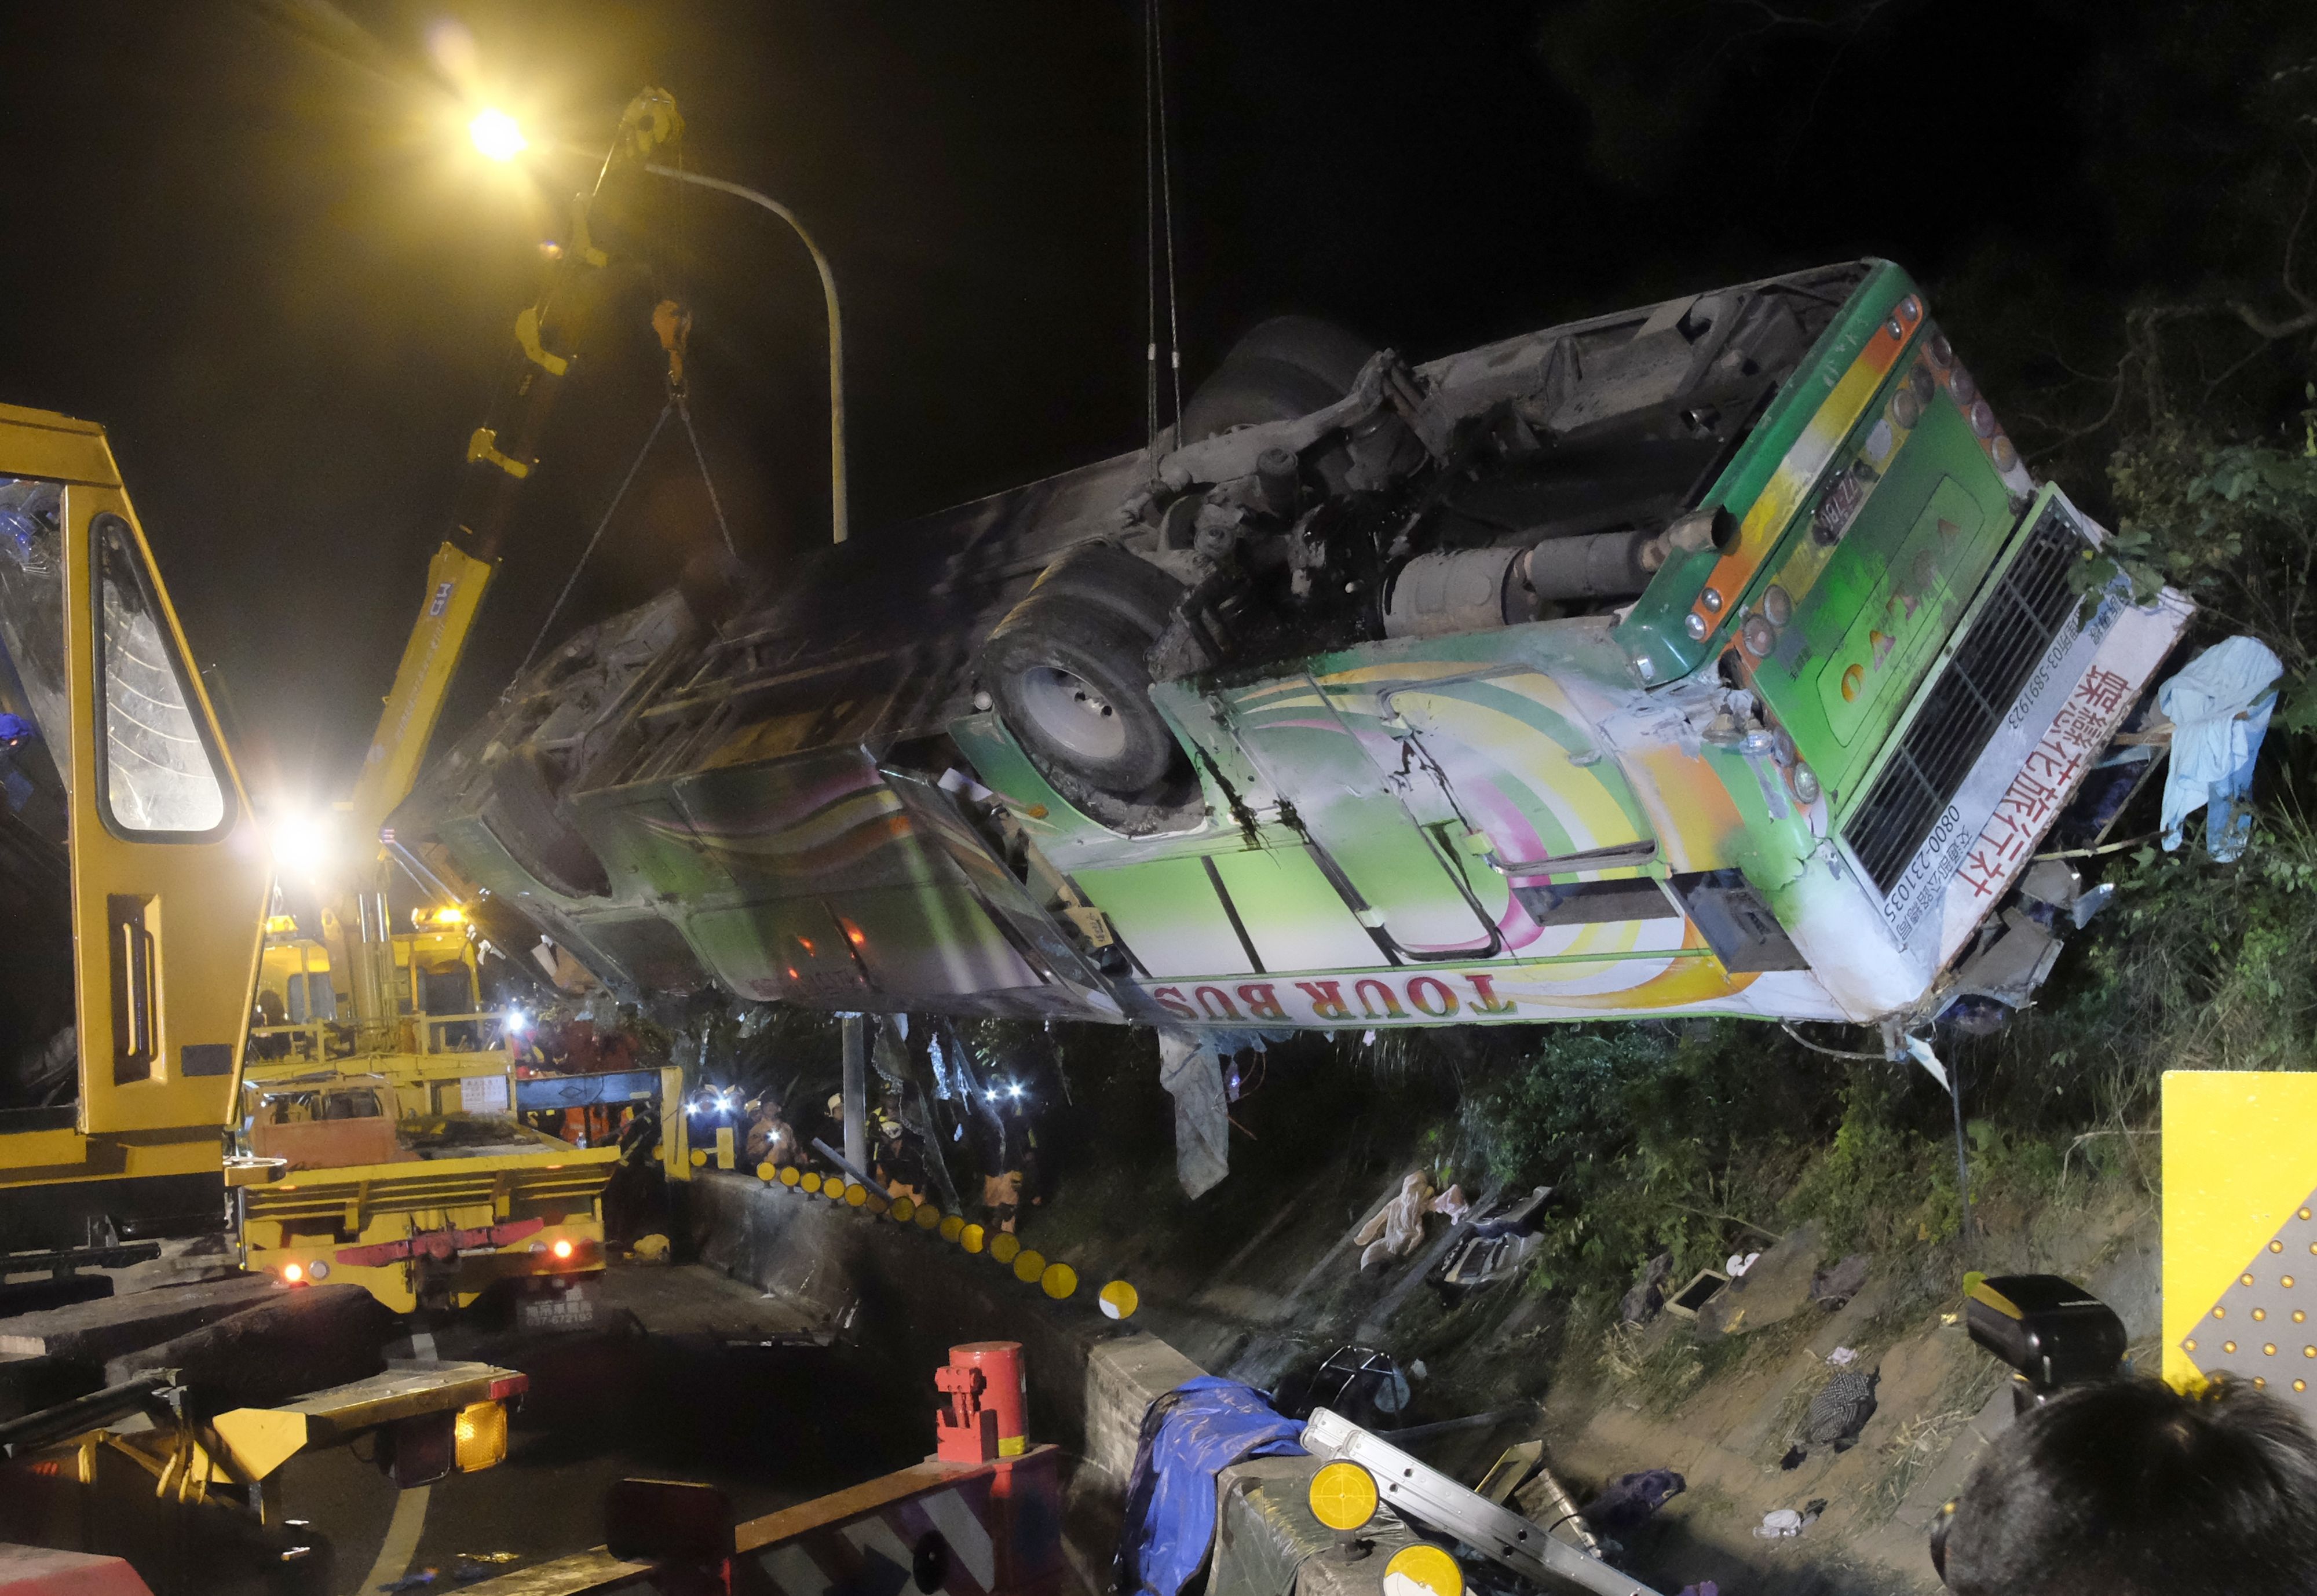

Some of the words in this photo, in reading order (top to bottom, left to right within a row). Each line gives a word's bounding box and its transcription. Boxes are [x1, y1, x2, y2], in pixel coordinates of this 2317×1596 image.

[2006, 605, 2083, 730] 理所03-5891923
[1957, 664, 2134, 898] 蝶戀花旅行社
[1883, 805, 1960, 923] 0800-231035
[1896, 824, 1973, 940] 交通部公路總局
[1154, 983, 1292, 1021] BUS
[1295, 974, 1518, 1021] TOUR
